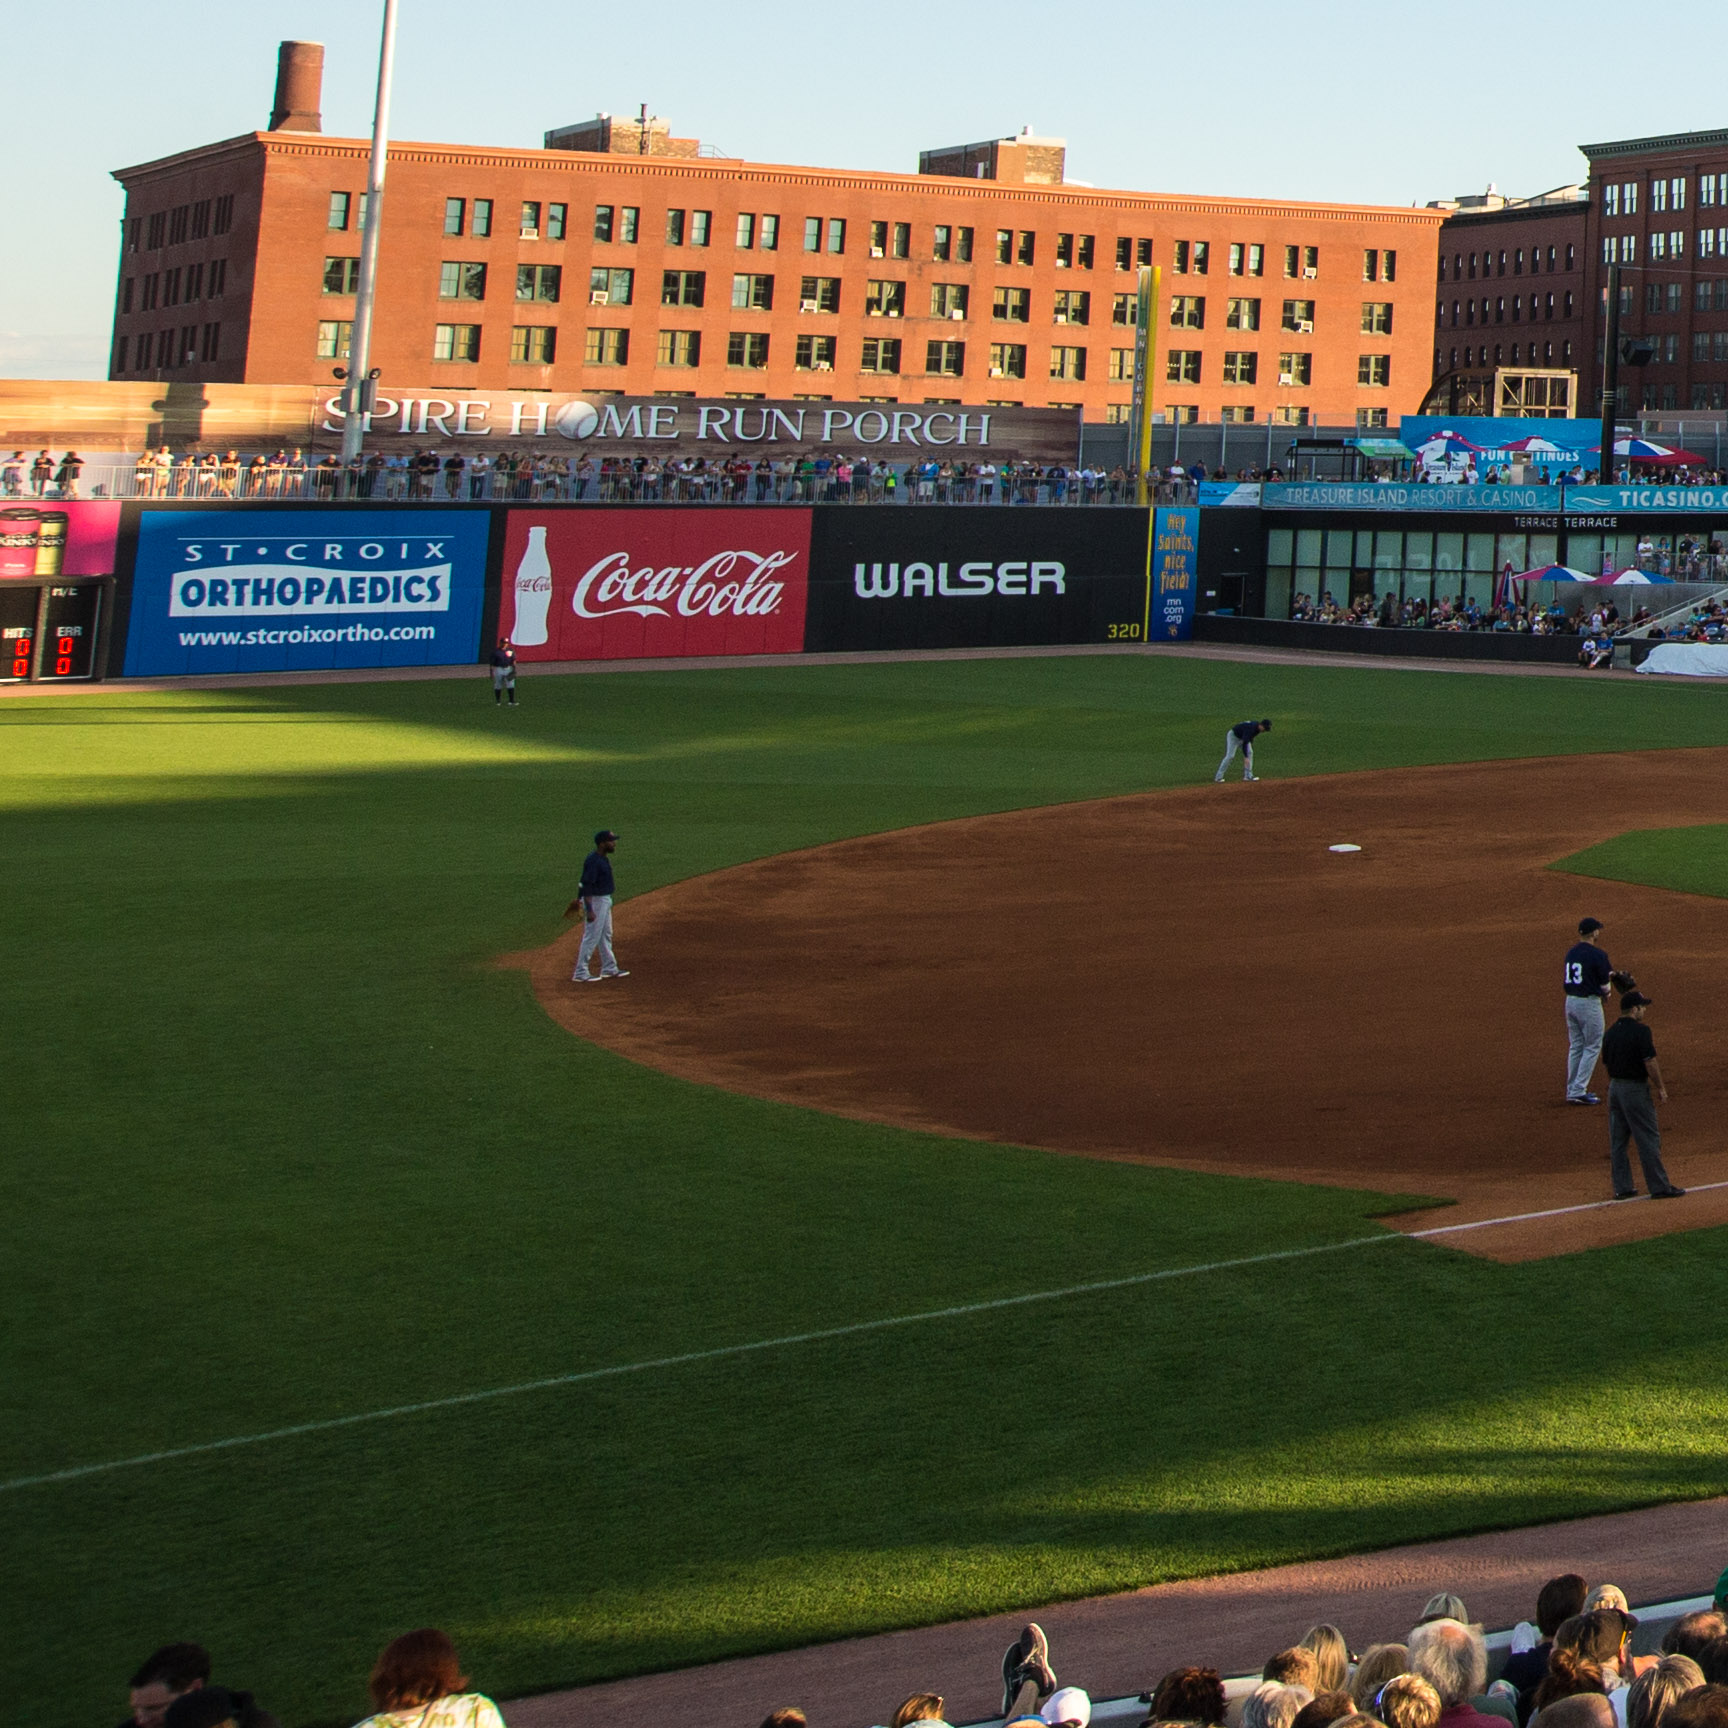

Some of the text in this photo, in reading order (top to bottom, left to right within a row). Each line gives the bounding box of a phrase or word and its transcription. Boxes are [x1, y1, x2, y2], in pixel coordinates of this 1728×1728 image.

[322, 396, 492, 438] SPIRE
[696, 406, 806, 443] RUN
[821, 409, 991, 447] PORCH
[1480, 450, 1505, 462] FUN
[1286, 487, 1537, 508] TREASURE ISLAND RESORT & CASINO
[1515, 517, 1558, 528] TERRACE
[1565, 517, 1618, 528] TERRACE
[572, 550, 799, 618] Coca-Cola
[854, 561, 1066, 599] WALSER
[180, 574, 443, 608] ORTHOPAEDICS
[2, 626, 83, 639] HITS ERR
[179, 623, 435, 647] www.stcroixortho.com
[1107, 623, 1140, 639] 320
[16, 637, 73, 656] 0 0
[13, 657, 71, 676] 0 0
[1565, 962, 1583, 984] 13
